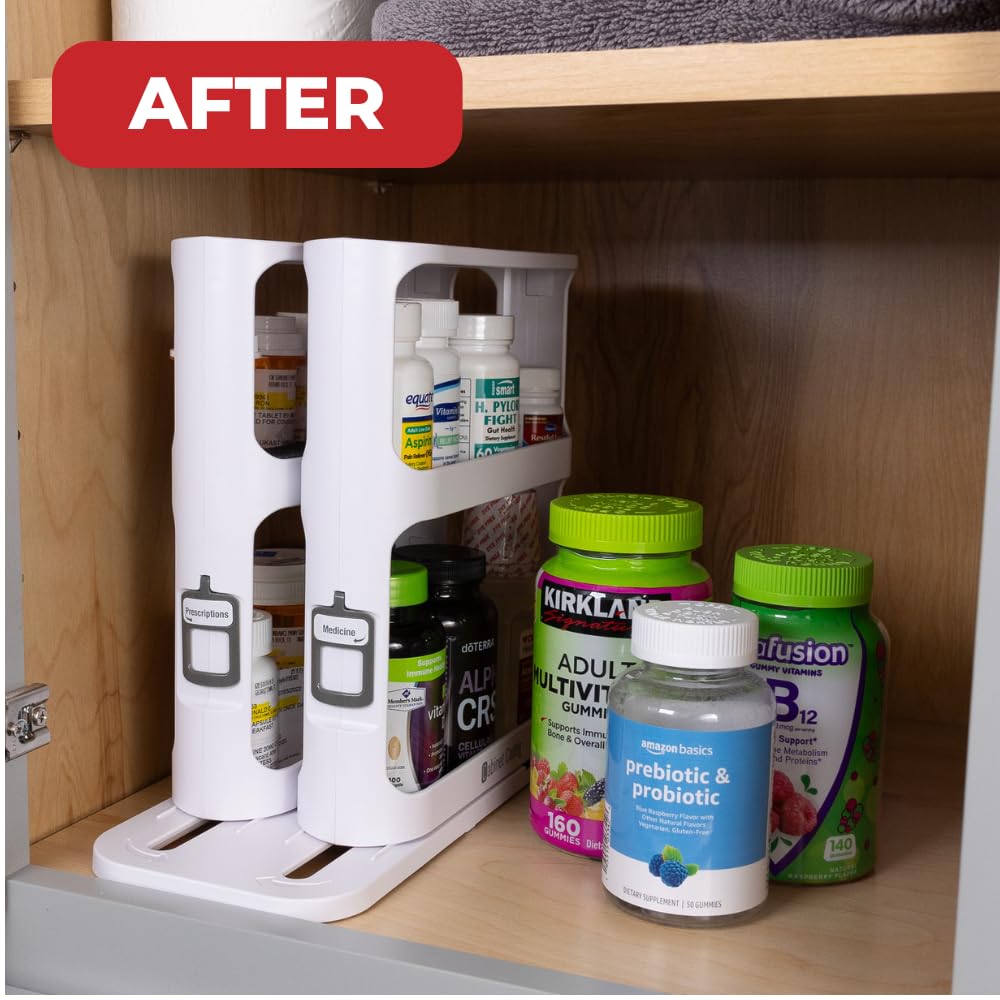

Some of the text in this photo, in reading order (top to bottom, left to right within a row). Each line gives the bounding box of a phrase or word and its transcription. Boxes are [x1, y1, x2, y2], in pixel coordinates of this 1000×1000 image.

[496, 384, 515, 396] smart
[475, 401, 488, 413] H.
[484, 414, 517, 426] FIGHT
[544, 586, 647, 620] KIRKLAN
[185, 607, 229, 619] Prescriptions
[322, 624, 356, 637] Medicine
[407, 667, 433, 678] Immune
[751, 662, 823, 677] GUMMY VITAMINS
[547, 718, 580, 735] Supports
[547, 729, 606, 750] Bone & Overall
[679, 743, 713, 756] basics
[783, 747, 828, 758] Metabolism
[626, 759, 731, 785] prebiotic &
[633, 782, 720, 806] probiotic
[649, 807, 679, 820] Raspberry
[680, 812, 700, 820] Flavor
[547, 811, 581, 837] 160
[642, 814, 707, 828] Other Natural Flavors
[544, 826, 581, 846] GUMMIES
[830, 838, 853, 852] 140
[623, 886, 722, 909] DIETARY SUPPLEMENT 50 GUMMIES
